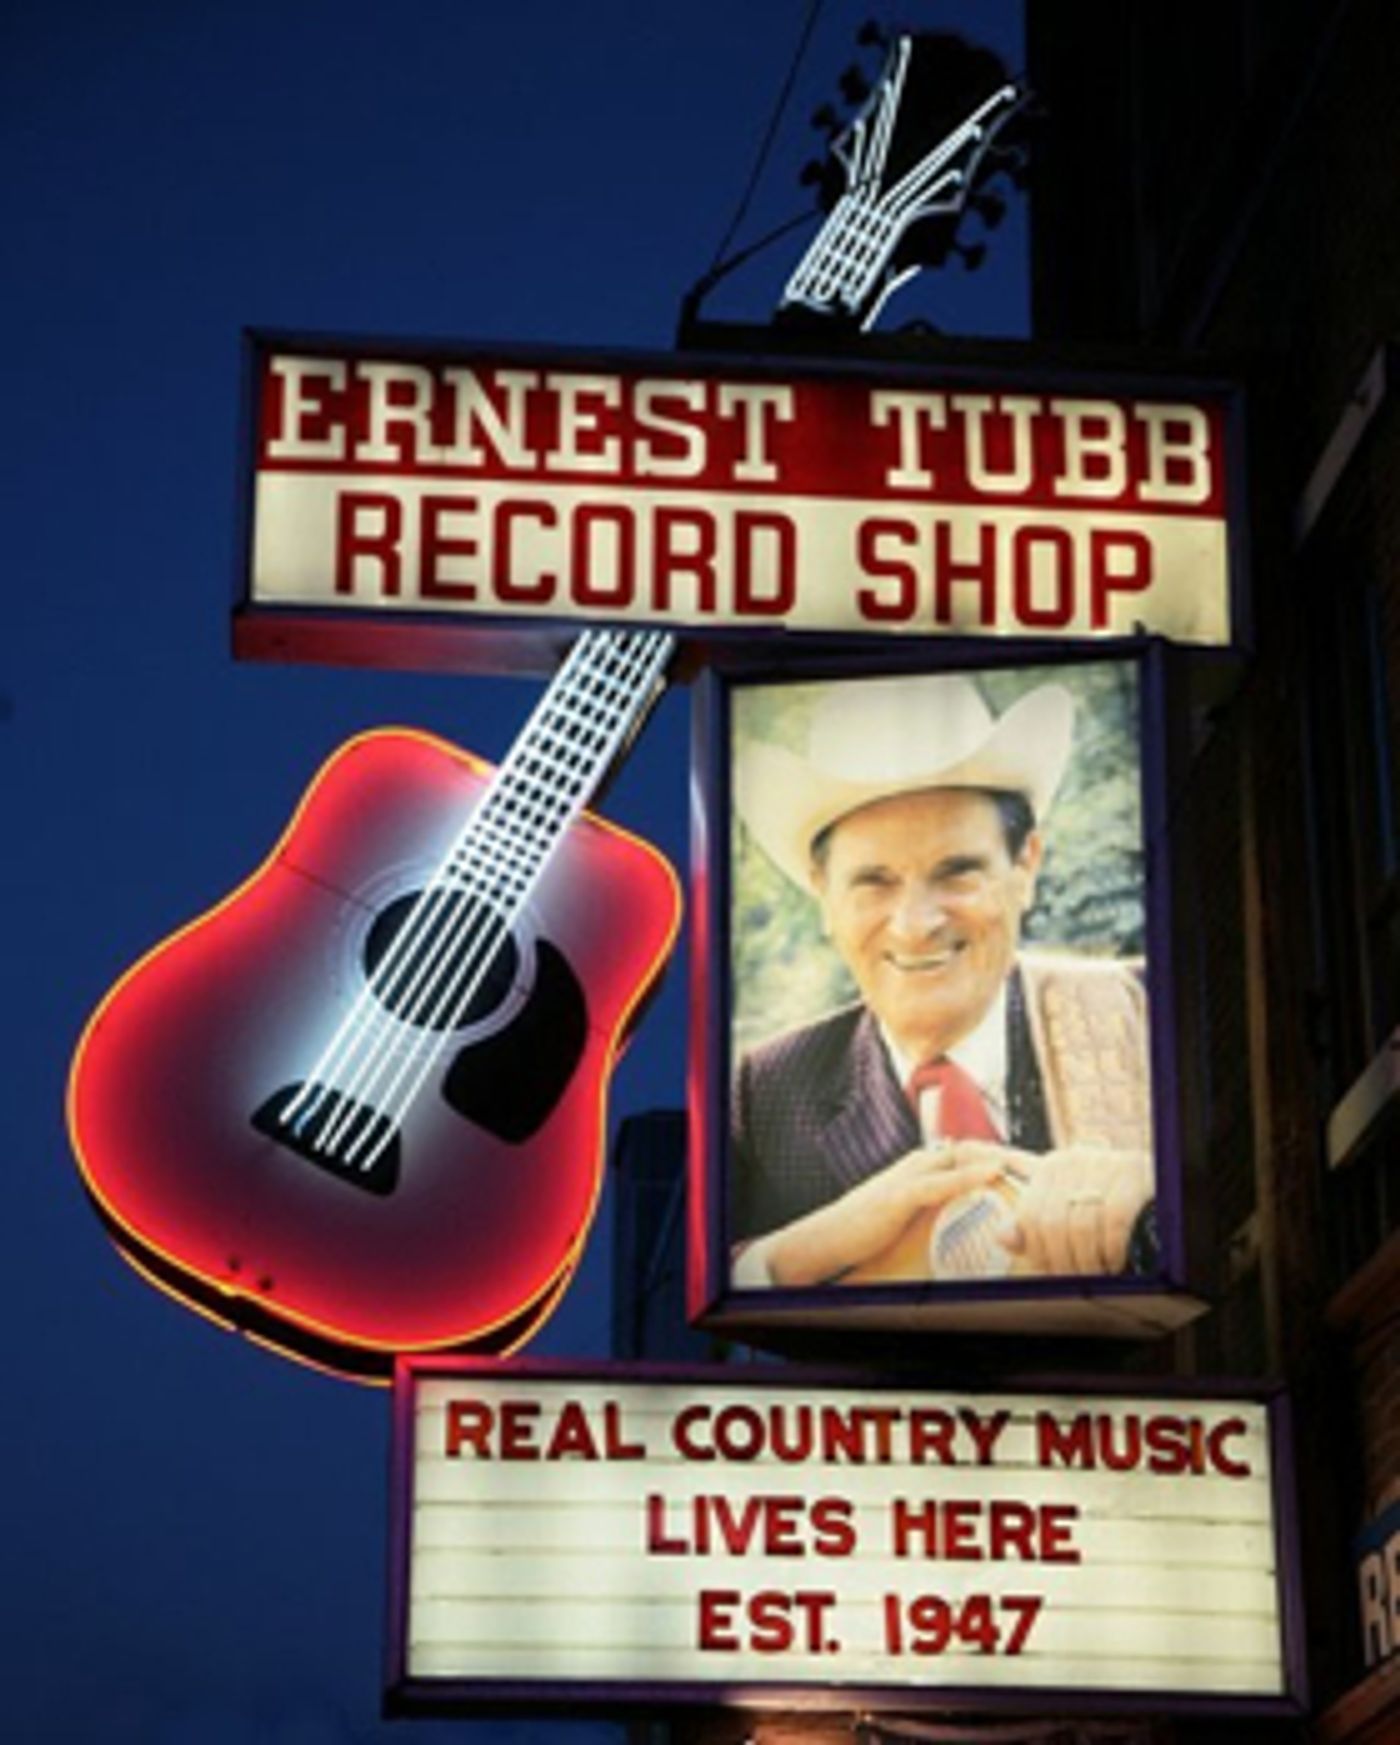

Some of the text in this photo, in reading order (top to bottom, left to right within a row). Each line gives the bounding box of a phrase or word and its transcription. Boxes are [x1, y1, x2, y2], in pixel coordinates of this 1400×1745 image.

[267, 355, 1212, 504] ERNEST TUBB
[335, 491, 1152, 630] RECORD SHOP
[445, 1401, 1251, 1477] REAL COUNTRY MUSIC
[646, 1494, 1081, 1564] LIVES HERE
[699, 1590, 1043, 1656] EST. 1947
